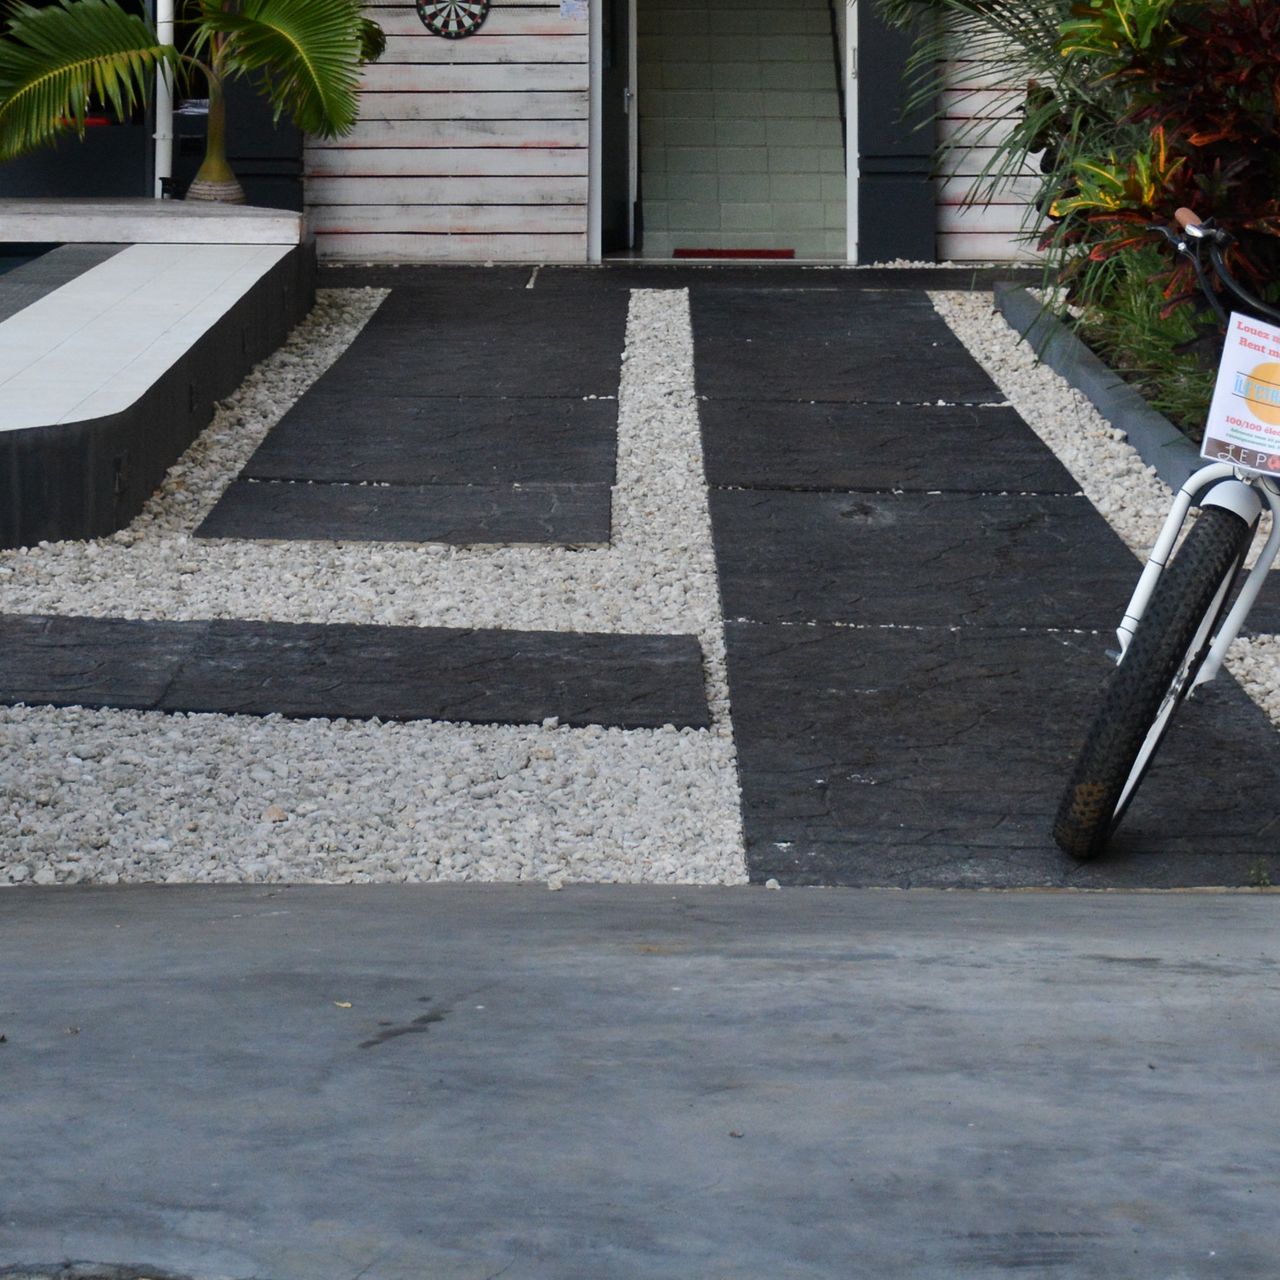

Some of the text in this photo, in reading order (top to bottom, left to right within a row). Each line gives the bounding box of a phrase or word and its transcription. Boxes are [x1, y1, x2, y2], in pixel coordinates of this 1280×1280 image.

[1235, 320, 1270, 340] Louez
[1238, 336, 1267, 354] Rent
[1224, 414, 1263, 433] 100/100
